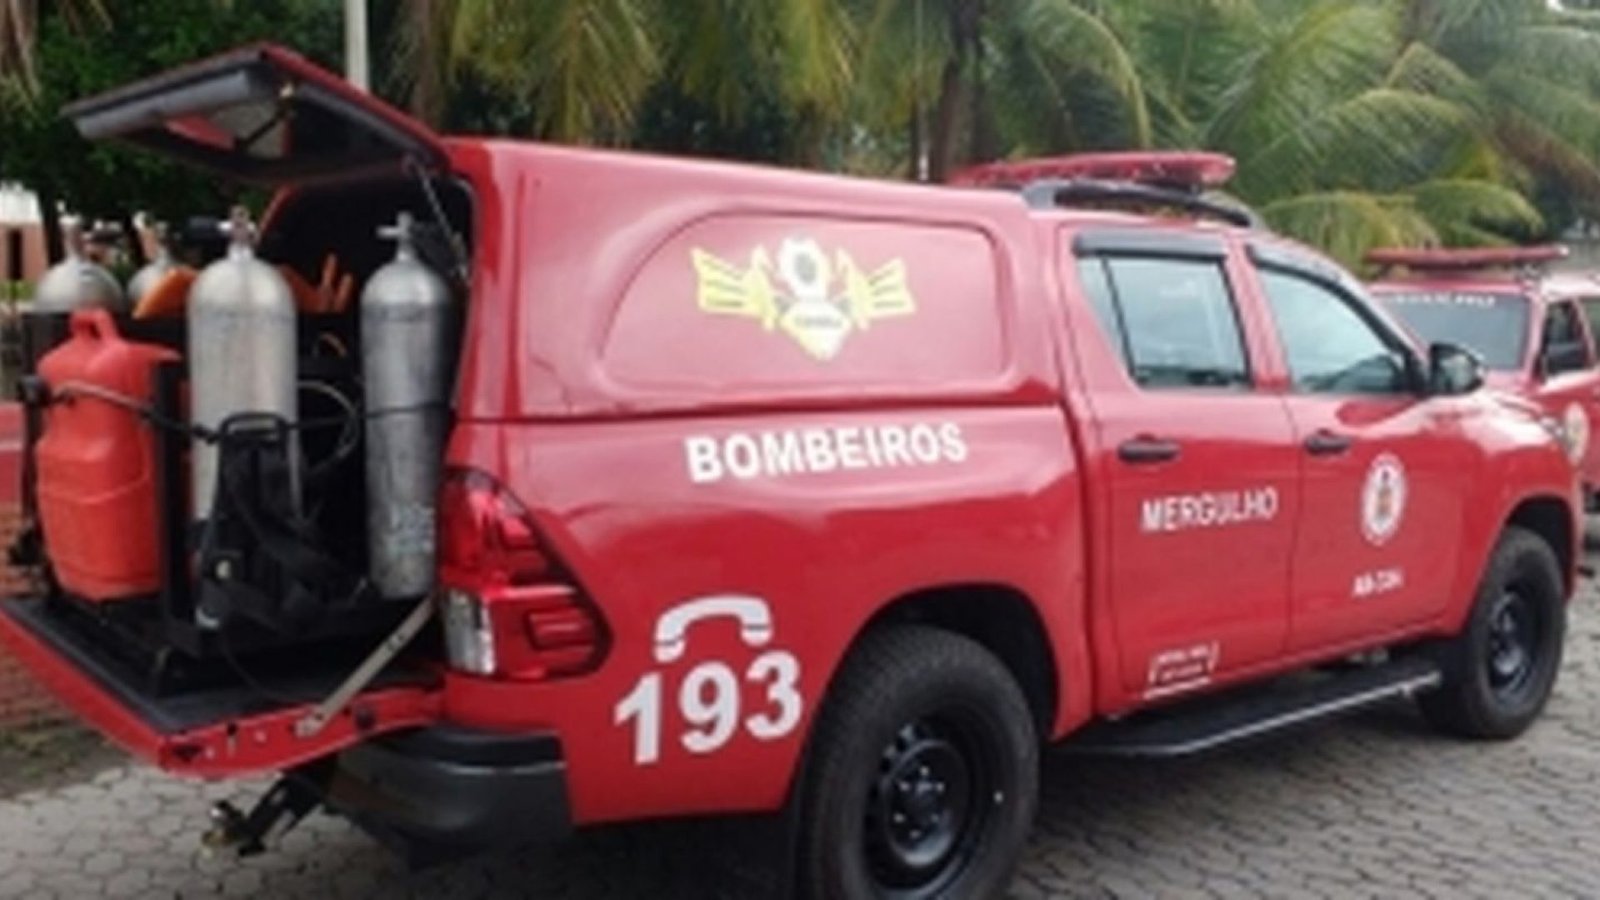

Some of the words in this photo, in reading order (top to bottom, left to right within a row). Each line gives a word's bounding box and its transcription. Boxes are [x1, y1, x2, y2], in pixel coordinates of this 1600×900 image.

[685, 422, 968, 483] BOMBEIROS
[1140, 486, 1279, 532] MERGULHO
[613, 651, 803, 766] 193
